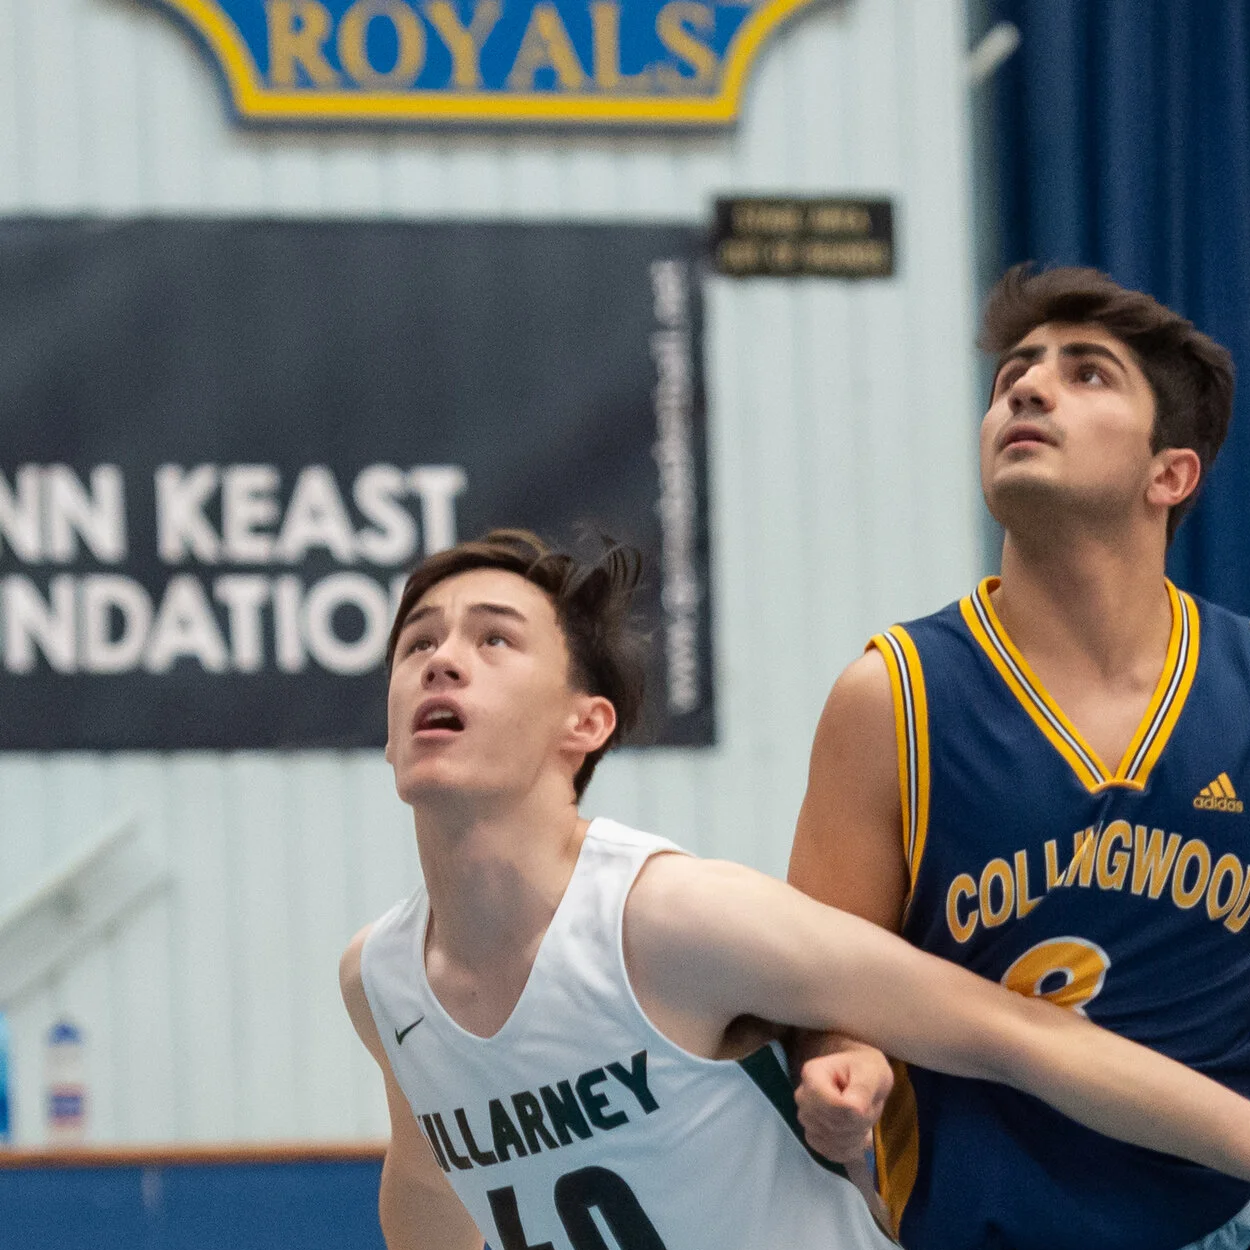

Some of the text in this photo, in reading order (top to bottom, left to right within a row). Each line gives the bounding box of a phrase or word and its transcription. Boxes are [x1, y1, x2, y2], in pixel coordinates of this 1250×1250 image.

[266, 0, 719, 91] ROYALS
[155, 464, 468, 564] KEAST
[2, 571, 405, 675] NDATIO
[1193, 796, 1244, 813] adidas
[416, 1049, 660, 1174] ILLARNEY
